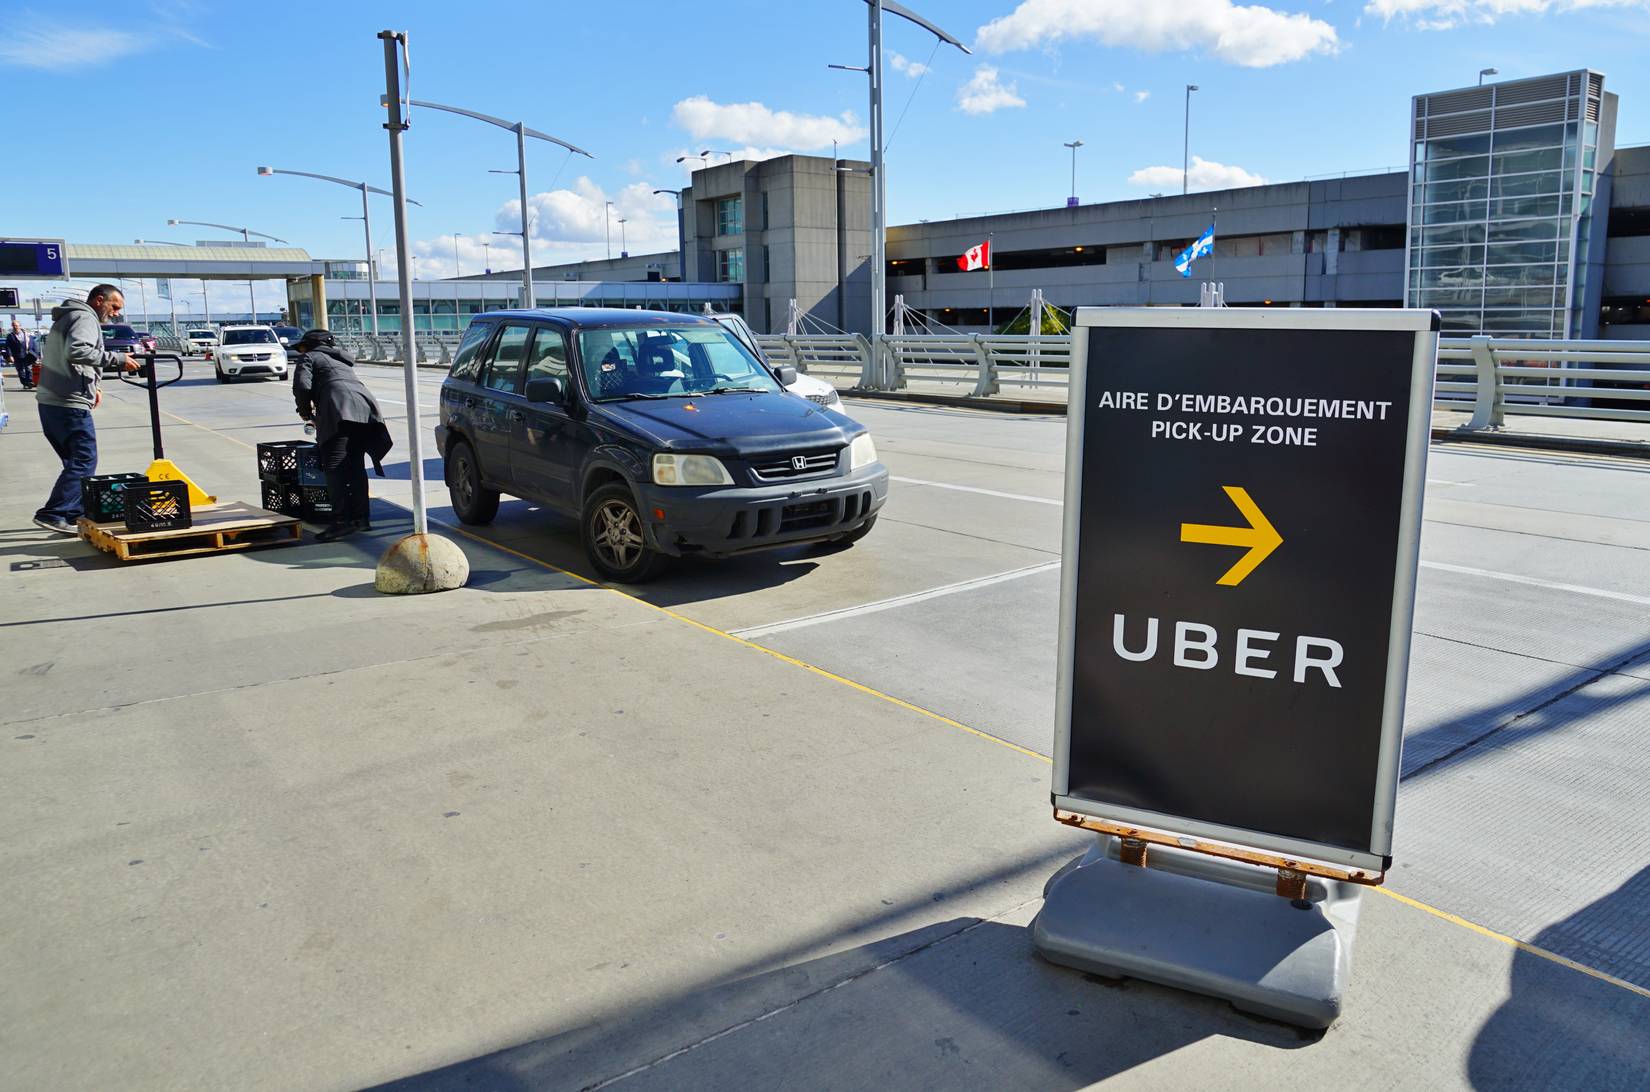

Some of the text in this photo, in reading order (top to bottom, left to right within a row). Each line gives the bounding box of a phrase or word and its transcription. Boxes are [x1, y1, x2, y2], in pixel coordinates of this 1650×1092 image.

[47, 248, 57, 260] 5
[1098, 391, 1392, 420] AIRE D'EMBARQUEMENT
[1151, 420, 1318, 447] PICK-UP ZONE
[1112, 613, 1344, 688] UBER
